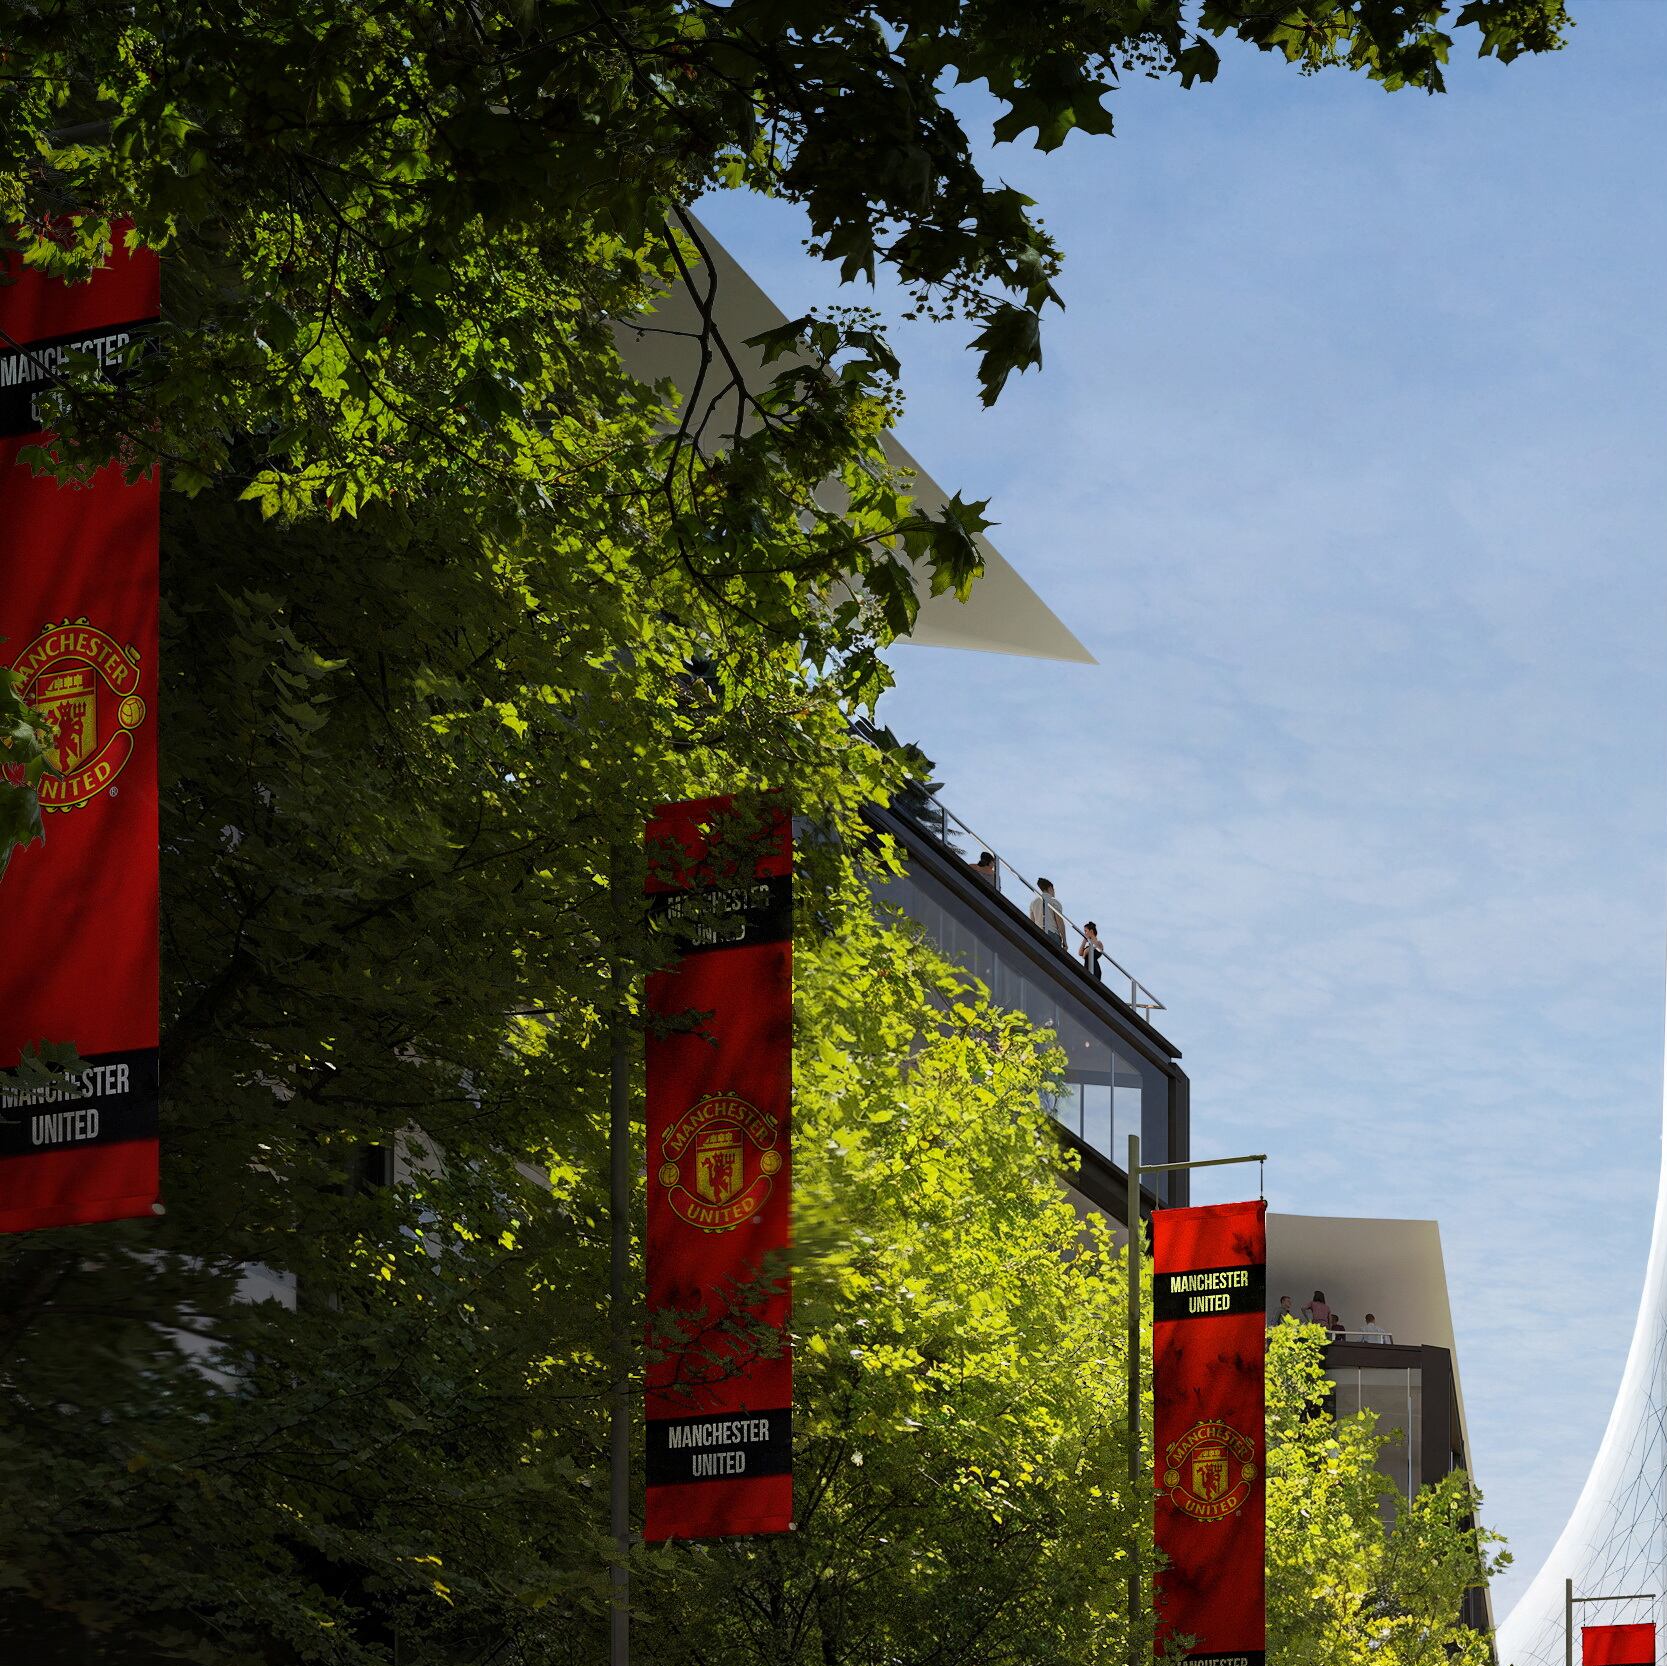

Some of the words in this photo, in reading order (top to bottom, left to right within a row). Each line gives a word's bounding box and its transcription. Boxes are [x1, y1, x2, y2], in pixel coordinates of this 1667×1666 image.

[40, 760, 113, 800] NITED
[32, 1109, 99, 1144] UNITED
[671, 1102, 770, 1151] MANCHESTER
[687, 1197, 755, 1225] UNITED
[1170, 1271, 1249, 1294] MANCHESTER
[1188, 1294, 1231, 1314] UNITED
[668, 1419, 770, 1449] MANCHESTER
[1172, 1425, 1249, 1462] MANCHESTER
[692, 1450, 746, 1478] UNITED
[1184, 1496, 1238, 1516] UNITED
